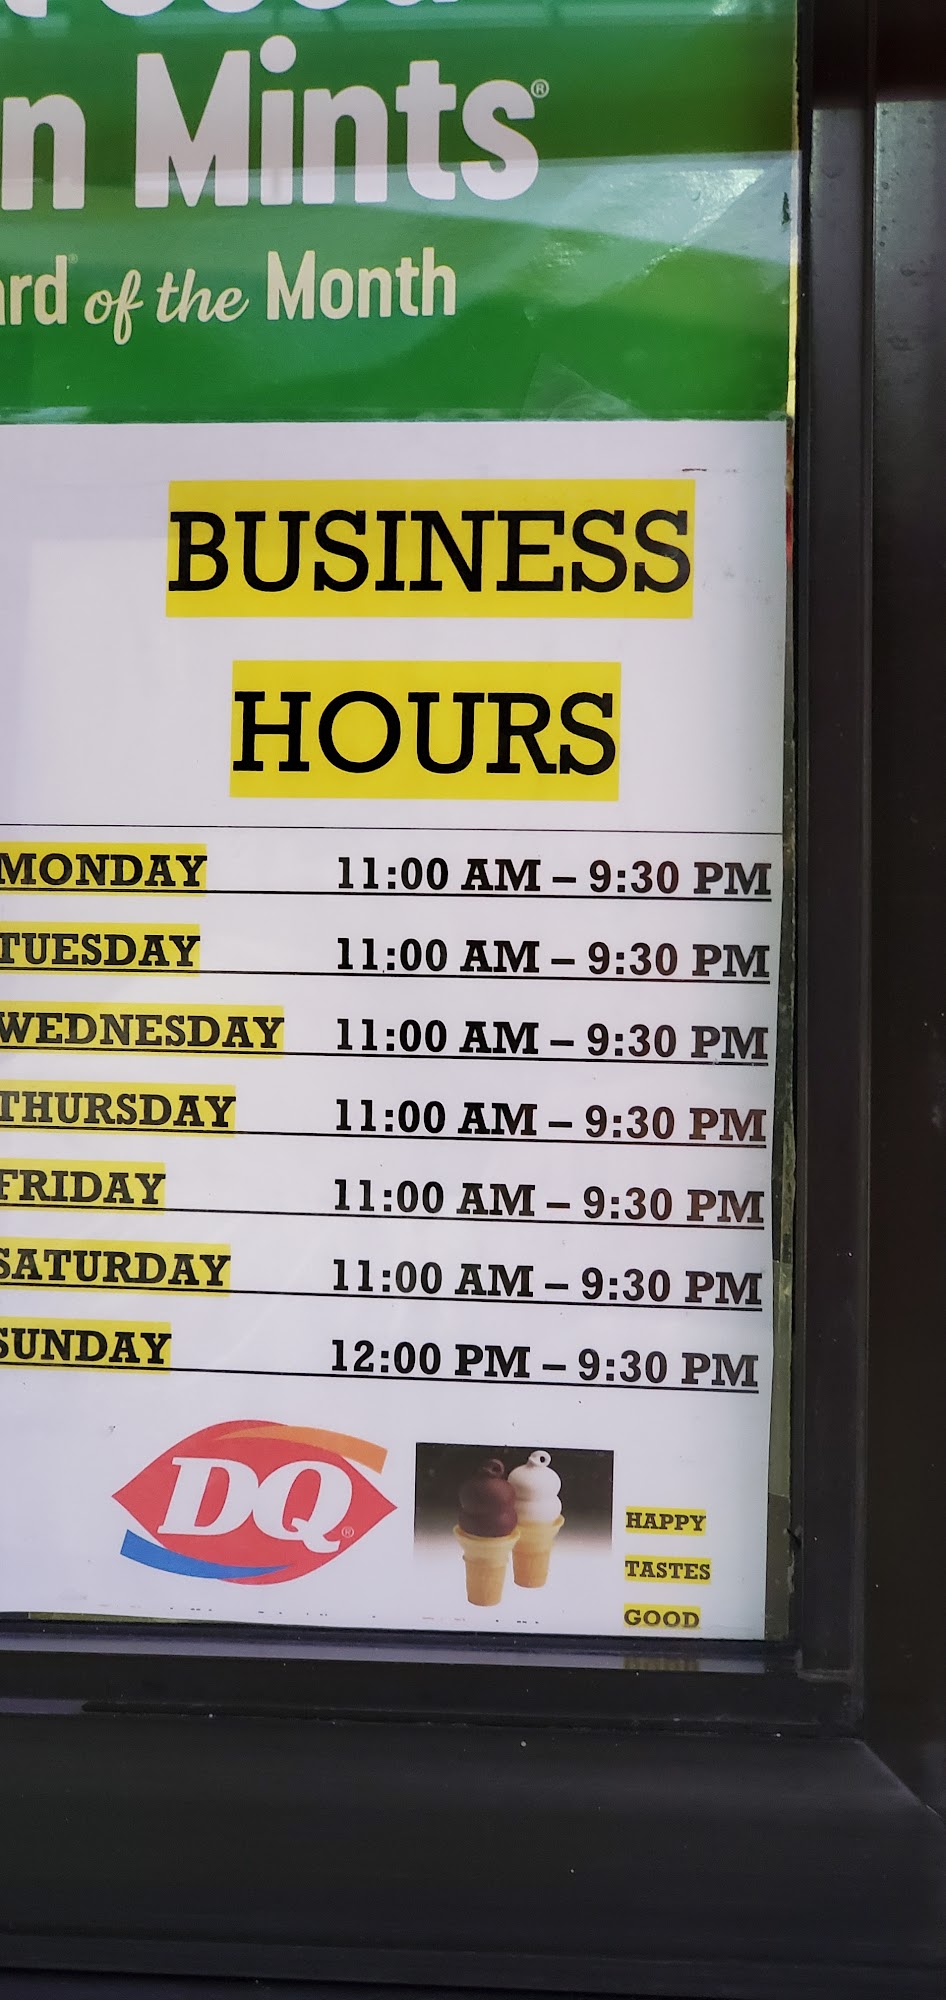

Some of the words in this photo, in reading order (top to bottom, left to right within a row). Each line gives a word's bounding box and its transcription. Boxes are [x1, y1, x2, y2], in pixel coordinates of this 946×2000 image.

[0, 254, 67, 326] rd
[84, 269, 143, 346] of
[156, 268, 250, 324] the
[266, 247, 457, 321] Month
[167, 509, 691, 593] BUSINESS
[232, 690, 617, 775] HOURS
[0, 852, 208, 887] MONDAY
[338, 857, 448, 890] 11:00
[461, 858, 541, 892] AM
[589, 860, 680, 894] 9:30
[693, 862, 771, 895] PM
[0, 932, 201, 967] TUESDAY
[337, 938, 447, 971] 11:00
[460, 940, 539, 973] AM
[588, 942, 678, 976] 9:30
[692, 944, 770, 978] PM
[0, 1011, 285, 1048] WEDNESDAY
[337, 1018, 447, 1052] 11:00
[459, 1021, 539, 1055] AM
[587, 1023, 677, 1058] 9:30
[691, 1025, 768, 1060] PM
[0, 1090, 237, 1128] THURSDAY
[336, 1098, 446, 1133] 11:00
[458, 1102, 538, 1136] AM
[585, 1105, 675, 1139] 9:30
[689, 1108, 766, 1141] PM
[0, 1169, 166, 1205] FRIDAY
[334, 1179, 444, 1213] 11:00
[456, 1182, 536, 1216] AM
[583, 1186, 673, 1220] 9:30
[686, 1189, 764, 1223] PM
[333, 1259, 442, 1294] 11:00
[454, 1263, 534, 1297] AM
[582, 1267, 671, 1302] 9:30
[684, 1271, 762, 1305] PM
[331, 1339, 441, 1374] 12:00
[455, 1344, 530, 1378] PM
[578, 1348, 668, 1383] 9:30
[681, 1352, 758, 1387] PM
[625, 1511, 707, 1532] HAPPY
[625, 1560, 711, 1580] TASTES
[624, 1609, 700, 1628] GOOD
